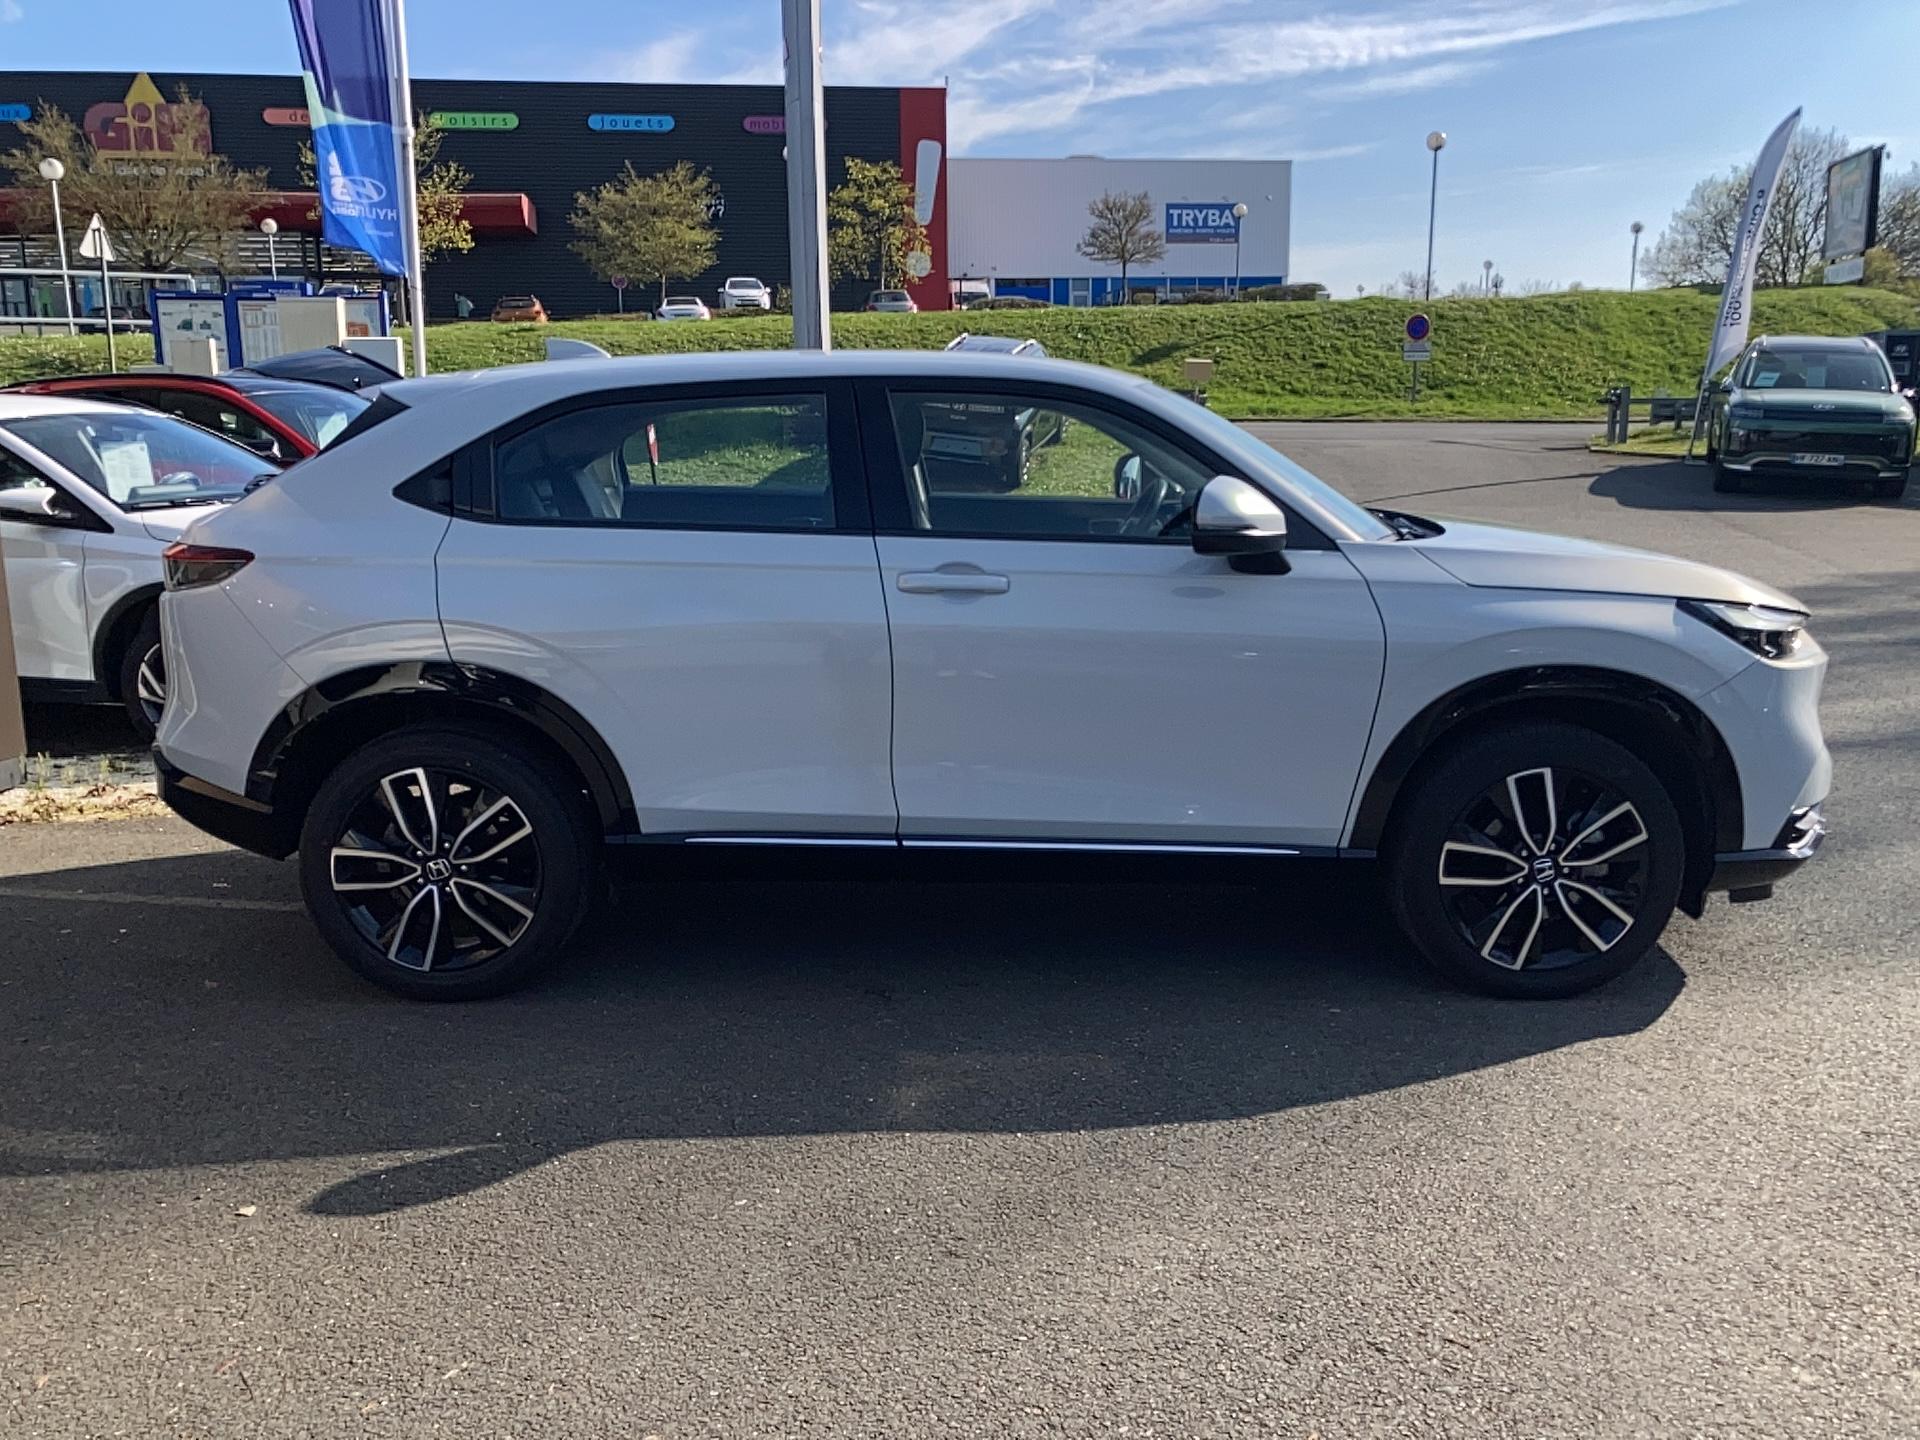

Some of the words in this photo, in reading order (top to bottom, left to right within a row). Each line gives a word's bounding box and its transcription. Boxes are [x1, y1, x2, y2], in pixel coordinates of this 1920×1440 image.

[600, 115, 665, 129] jouets
[749, 118, 785, 130] mobi
[1169, 209, 1235, 227] TRYBA
